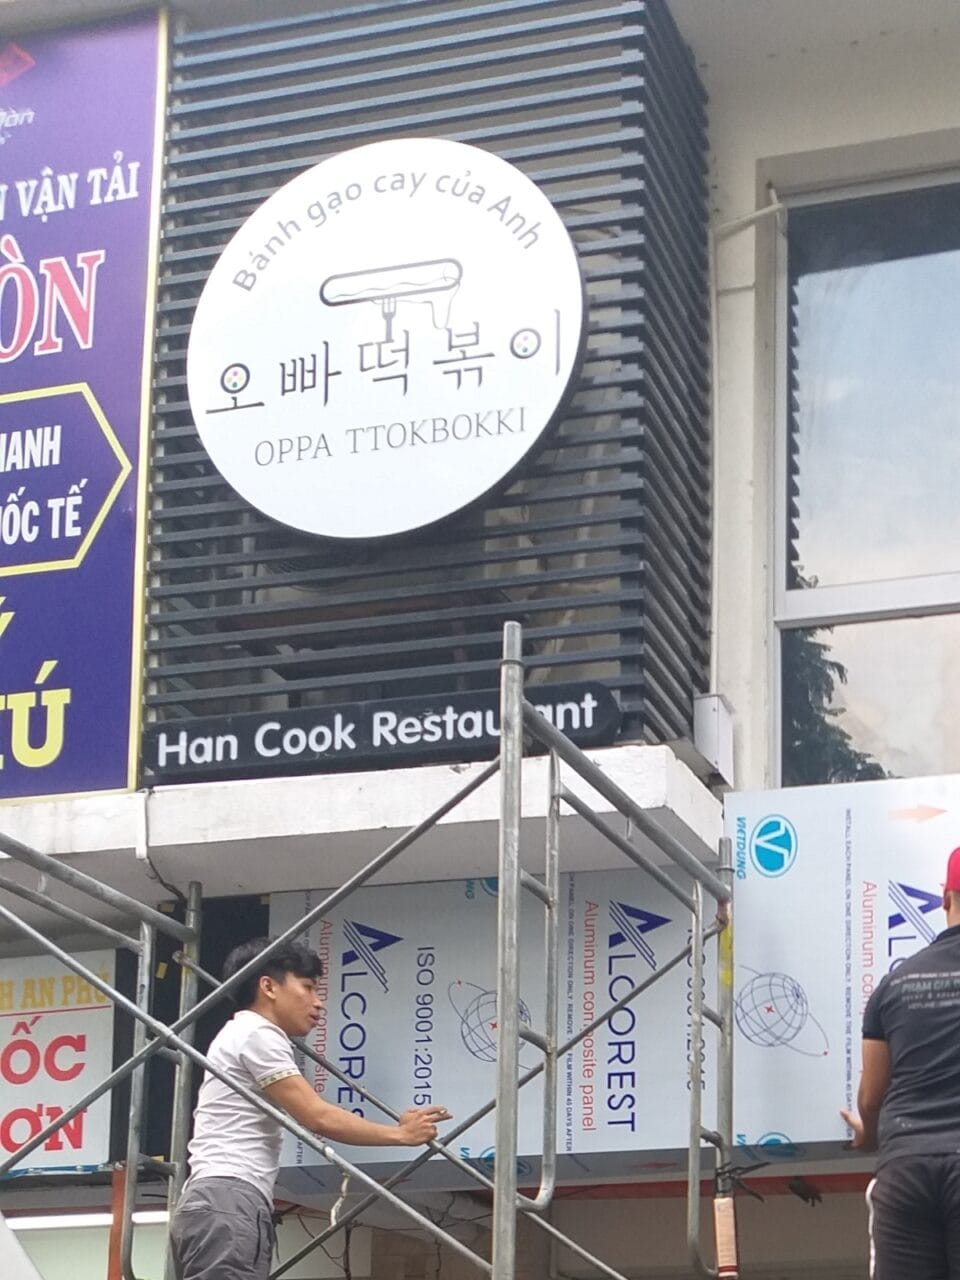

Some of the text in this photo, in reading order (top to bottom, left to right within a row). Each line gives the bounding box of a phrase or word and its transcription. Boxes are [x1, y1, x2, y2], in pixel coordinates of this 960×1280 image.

[16, 166, 79, 223] VẬN
[87, 150, 141, 205] TẢI
[232, 170, 544, 292] Bánh gạo cay của Anh
[254, 406, 527, 467] OPPA TTOKBOKKI
[48, 478, 88, 539] TẾ
[0, 660, 71, 768] Ú
[157, 692, 599, 768] Han Cook Restauant
[735, 816, 747, 880] VIETDUNG
[582, 900, 600, 985] Aluminum
[861, 880, 878, 967] Aluminum
[313, 1008, 330, 1093] compsite
[338, 919, 405, 1122] ALCORE
[413, 946, 436, 1106] ISO 9001:2015
[607, 900, 673, 1132] ALCOREST
[579, 1084, 597, 1131] panel
